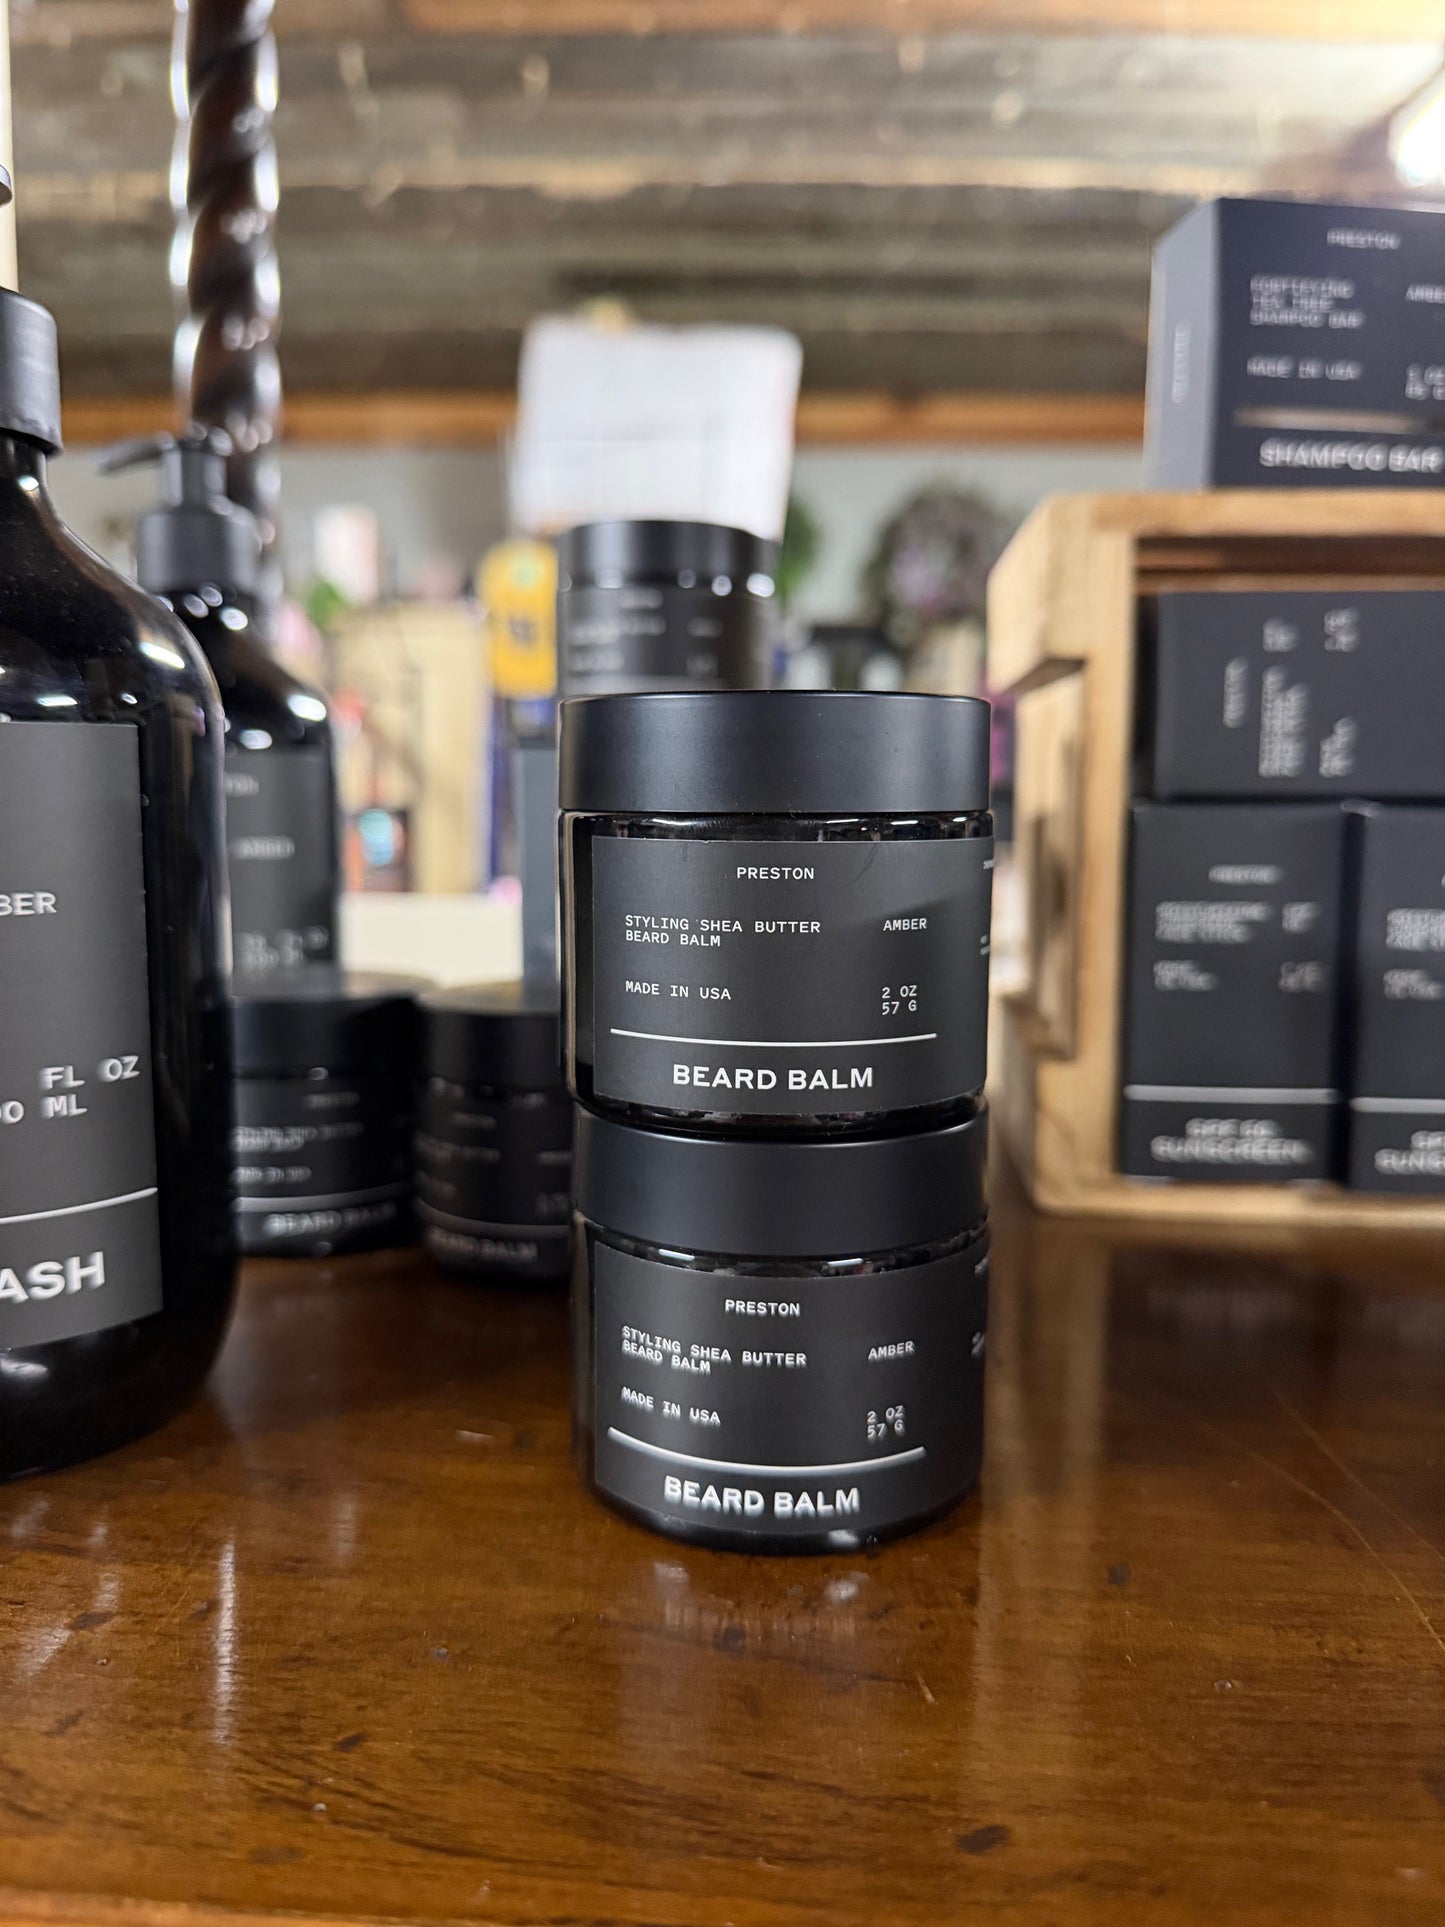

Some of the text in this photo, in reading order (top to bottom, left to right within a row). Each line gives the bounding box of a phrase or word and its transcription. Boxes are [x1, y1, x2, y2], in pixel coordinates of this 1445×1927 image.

[1259, 438, 1389, 471] SHAMPOO
[735, 866, 815, 881] PRESTON
[625, 914, 821, 933] STYLING SHEA BUTTER
[882, 917, 927, 932] AMBER
[625, 929, 721, 947] BEARD BALM
[625, 980, 731, 1000] MADE IN USA
[881, 984, 918, 999] 2 OZ
[881, 999, 918, 1016] 57 G
[39, 1055, 140, 1090] FL OZ
[672, 1063, 874, 1091] BEARD BALM
[40, 1093, 88, 1119] ML
[725, 1298, 801, 1318] PRESTON
[621, 1325, 808, 1367] STYLING SHEA BUTTER
[867, 1340, 915, 1361] AMBER
[621, 1339, 711, 1375] BEARD BALM
[621, 1386, 721, 1426] MADE IN USA
[867, 1404, 905, 1424] 2 OZ
[867, 1419, 905, 1442] 57 G
[664, 1474, 860, 1519] BEARD BALM
